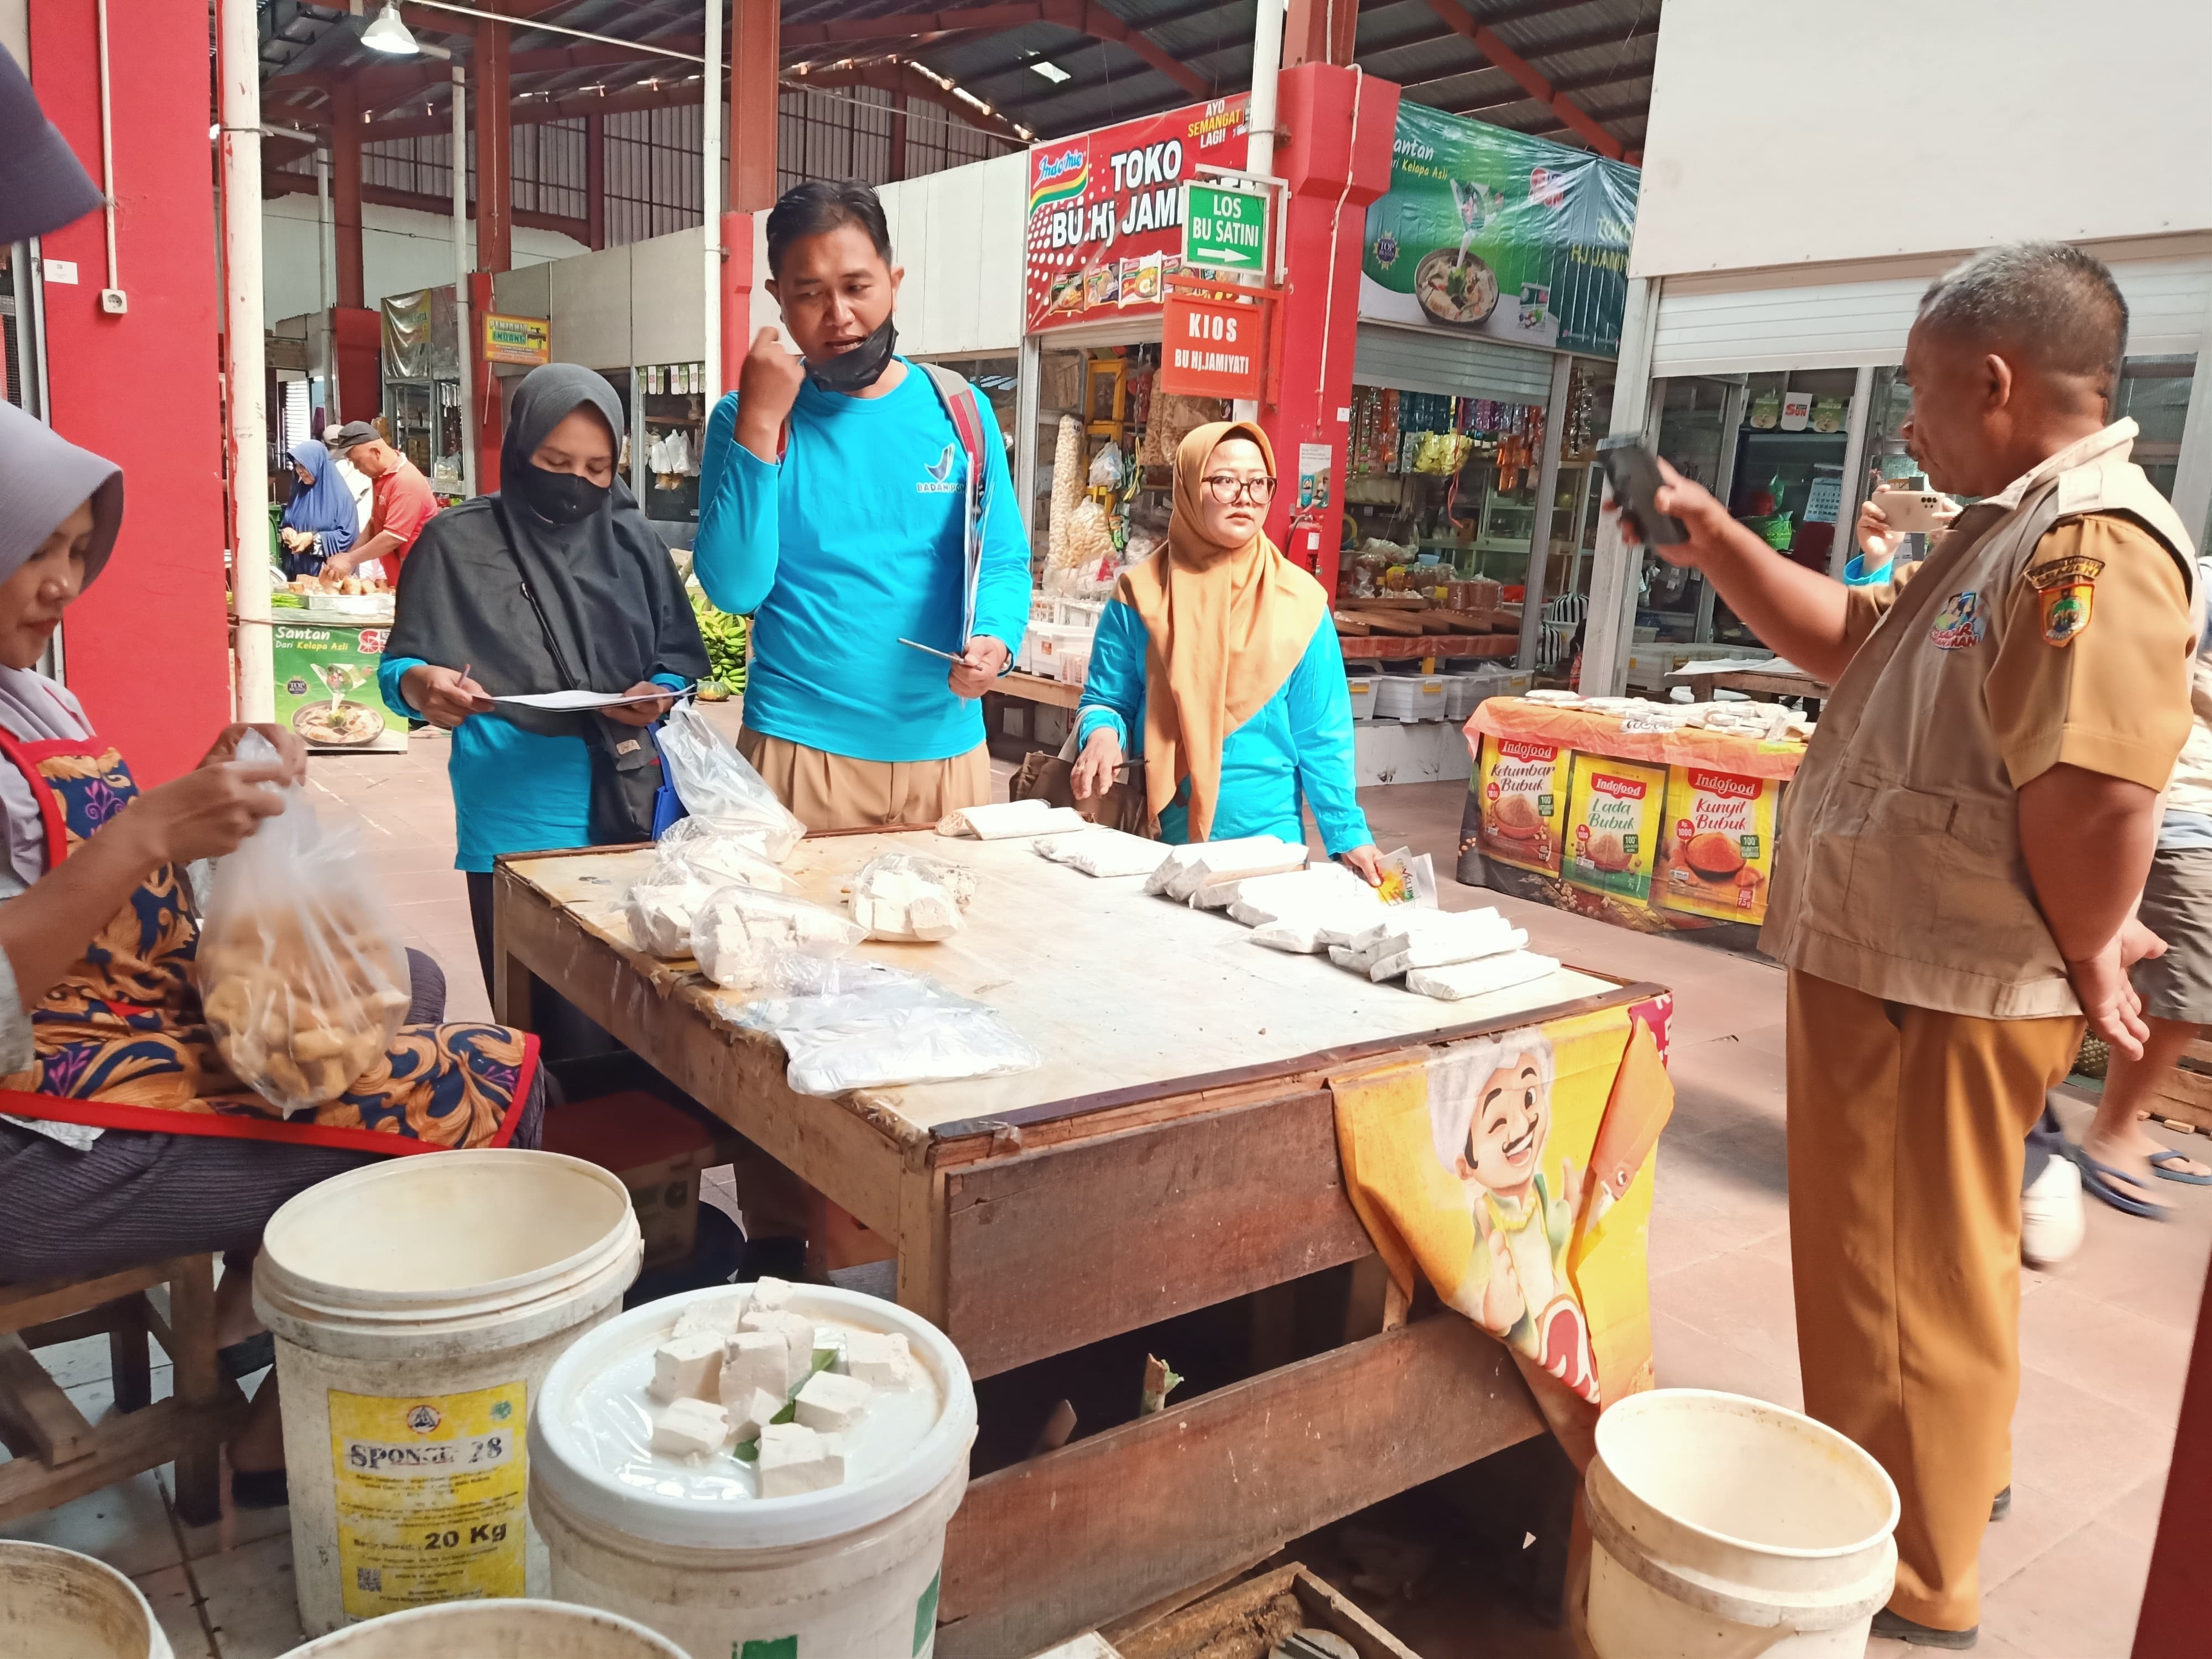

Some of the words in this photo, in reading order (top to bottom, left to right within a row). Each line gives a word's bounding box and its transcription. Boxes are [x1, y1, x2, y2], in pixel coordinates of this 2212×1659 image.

[1206, 100, 1225, 118] AYO
[1188, 108, 1241, 137] SEMANGAT
[1201, 128, 1225, 149] LAGI!
[1393, 138, 1434, 161] antan
[1111, 140, 1182, 192] TOKO
[1402, 158, 1430, 178] Kelapa
[1432, 166, 1448, 180] Asli
[1213, 195, 1241, 219] LOS
[1192, 216, 1212, 241] BU
[1215, 220, 1259, 248] SATINI
[1189, 312, 1237, 342] KIOS
[1175, 348, 1190, 369] BU
[1785, 404, 1807, 416] SUN
[917, 483, 949, 492] BADAN
[275, 626, 331, 640] Santan
[275, 640, 294, 649] Dari
[297, 641, 328, 652] Kelapa
[331, 642, 349, 651] Asli
[1502, 740, 1553, 759] Indofood
[1490, 764, 1556, 777] Ketumbar
[1500, 778, 1544, 792] Bubuk
[1596, 778, 1642, 796] Indofood
[1695, 773, 1756, 796] Indofood
[1592, 798, 1631, 815] Lada
[1696, 798, 1746, 818] Kunyit
[1588, 813, 1636, 830] Bubuk
[1695, 814, 1747, 830] Bubuk
[1678, 828, 1692, 837] 1000
[468, 1436, 503, 1464] 28
[425, 1530, 460, 1550] 20
[470, 1522, 507, 1544] Kg
